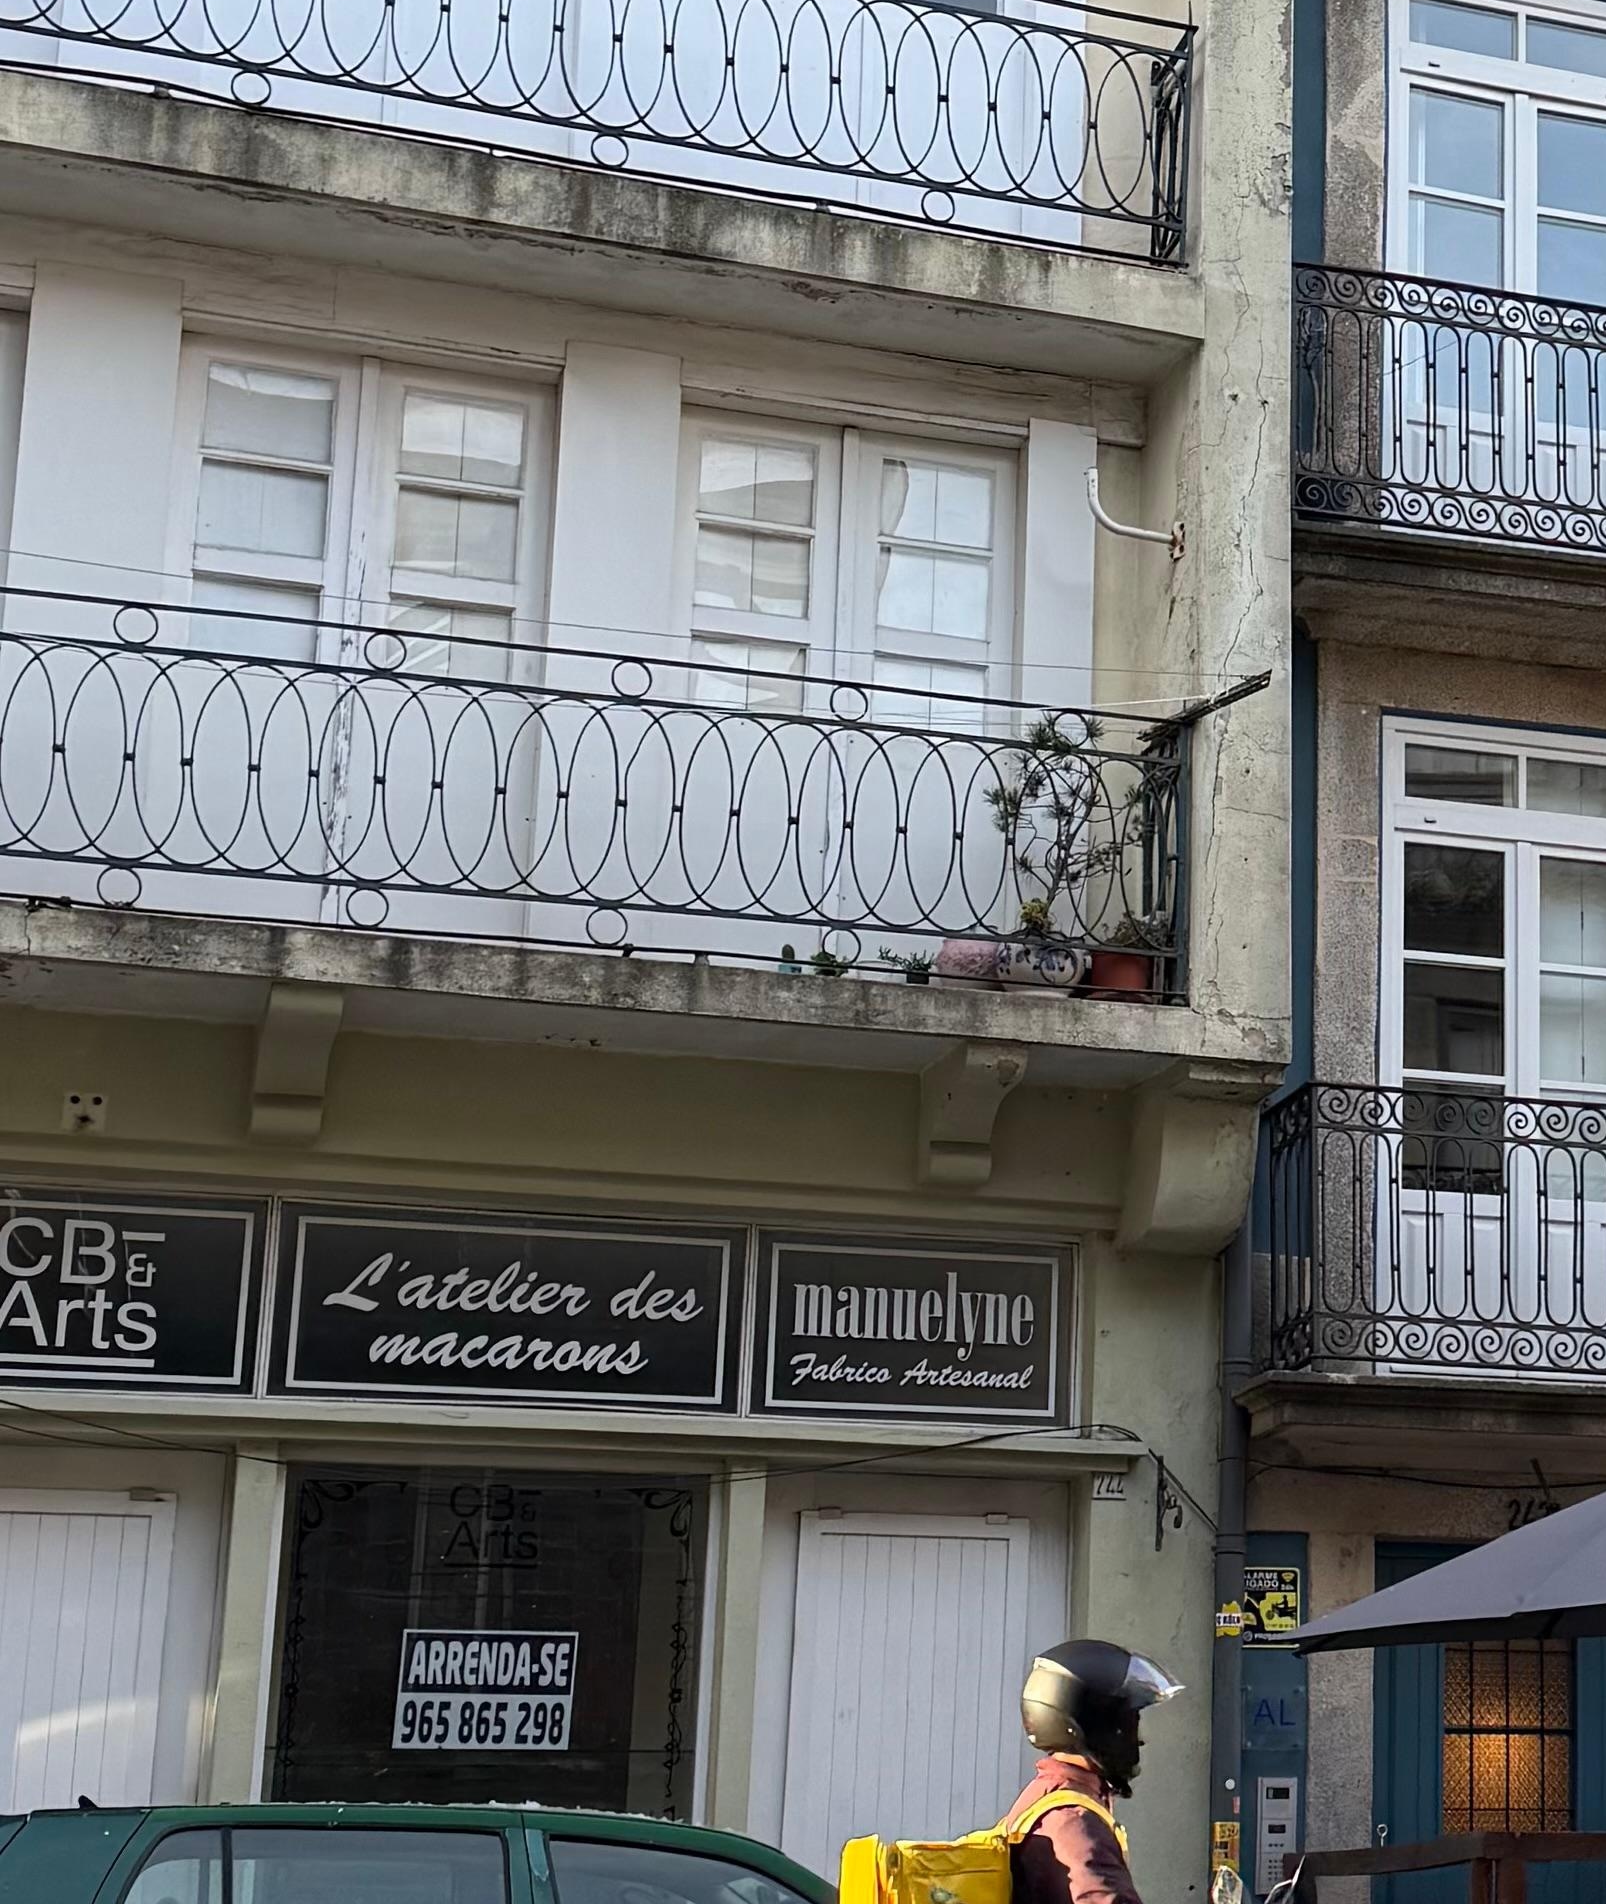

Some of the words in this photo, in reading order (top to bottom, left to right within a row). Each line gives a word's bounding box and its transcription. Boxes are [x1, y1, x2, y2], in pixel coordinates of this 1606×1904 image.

[322, 1252, 591, 1317] L'atelier
[610, 1270, 703, 1322] des
[0, 1280, 157, 1351] Arts
[792, 1272, 1034, 1361] manuelyne
[369, 1332, 648, 1375] macarons
[790, 1353, 892, 1386] Fabrico
[900, 1358, 1034, 1389] Artesanal
[445, 1521, 538, 1559] Arts
[407, 1640, 570, 1686] ARRENDA-SE
[401, 1700, 451, 1744] 965
[458, 1701, 508, 1744] 865
[515, 1702, 565, 1745] 298
[1254, 1698, 1296, 1726] AL
